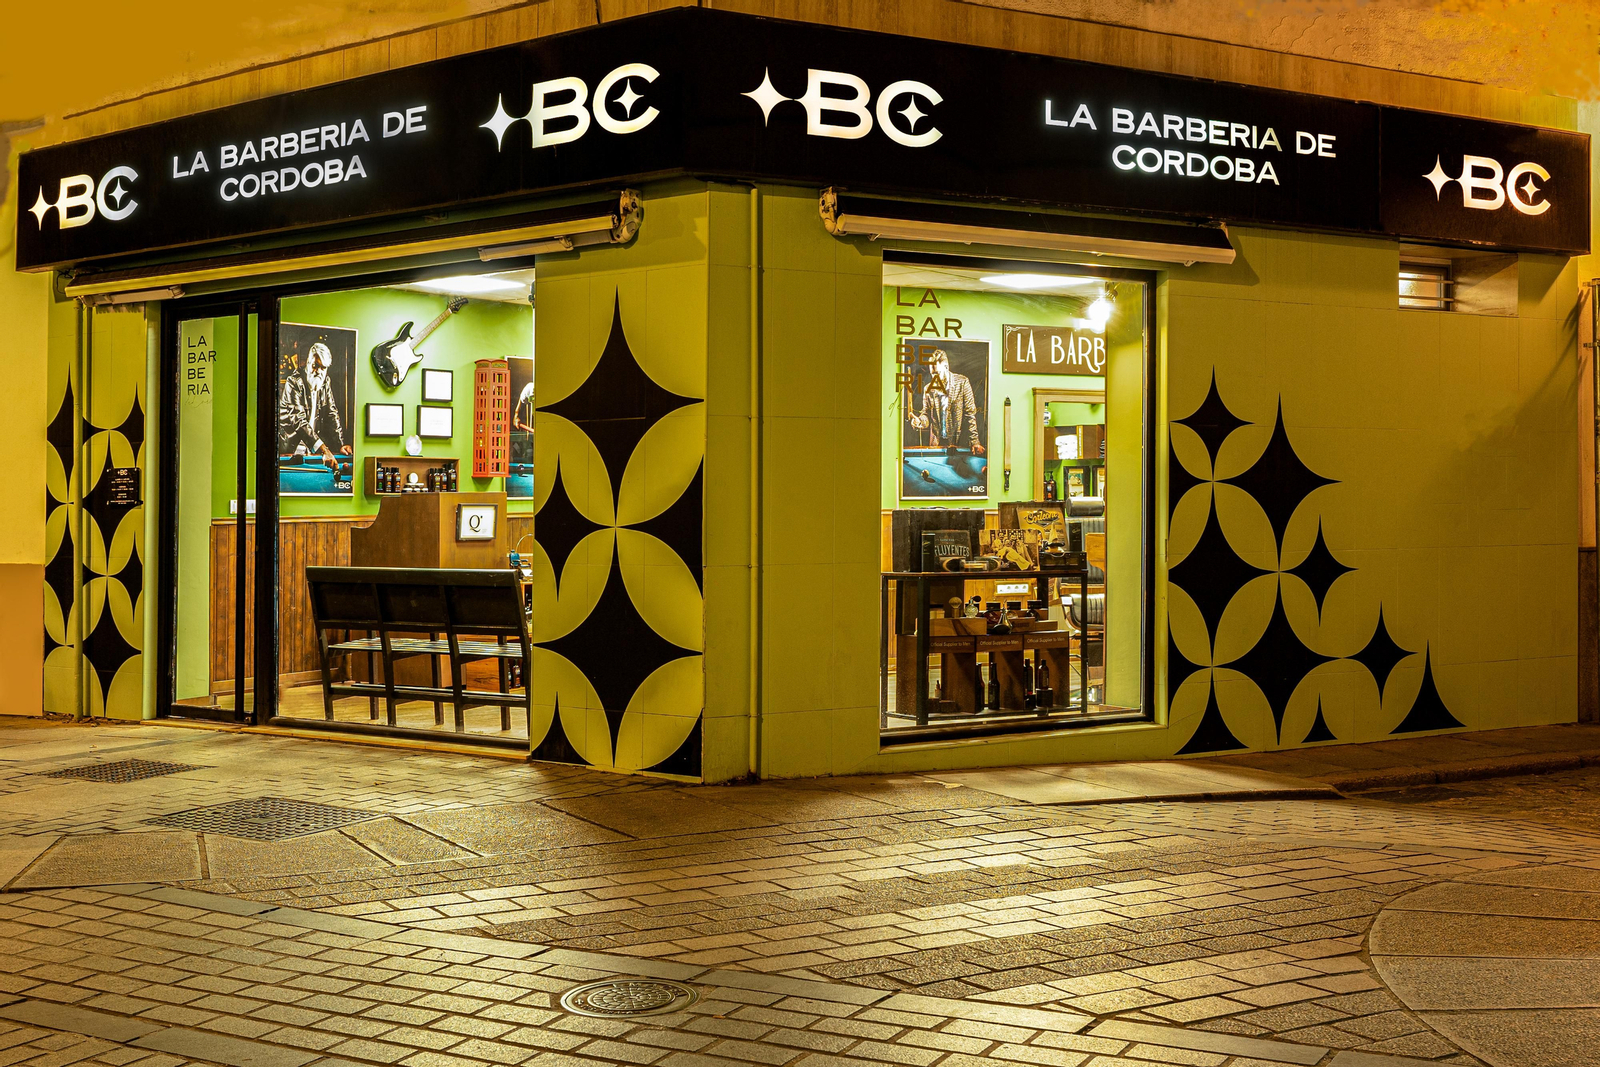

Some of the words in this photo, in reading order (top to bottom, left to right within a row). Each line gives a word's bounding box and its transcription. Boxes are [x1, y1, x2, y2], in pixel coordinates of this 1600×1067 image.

[1045, 99, 1097, 131] LA
[1111, 107, 1282, 152] BARBERIA
[1295, 130, 1337, 158] DE
[172, 151, 210, 179] LA
[220, 119, 371, 170] BARBERIA
[382, 105, 427, 139] DE
[1111, 144, 1280, 186] CORDOBA
[219, 155, 367, 202] CORDOBA
[897, 286, 941, 308] LA
[896, 315, 962, 338] BAR
[188, 335, 207, 348] LA
[1017, 330, 1037, 363] LA
[1051, 331, 1105, 373] BARB
[188, 350, 217, 364] BAR
[896, 344, 938, 366] BE
[188, 367, 206, 380] BE
[896, 373, 948, 394] RIA
[188, 383, 210, 396] RIA
